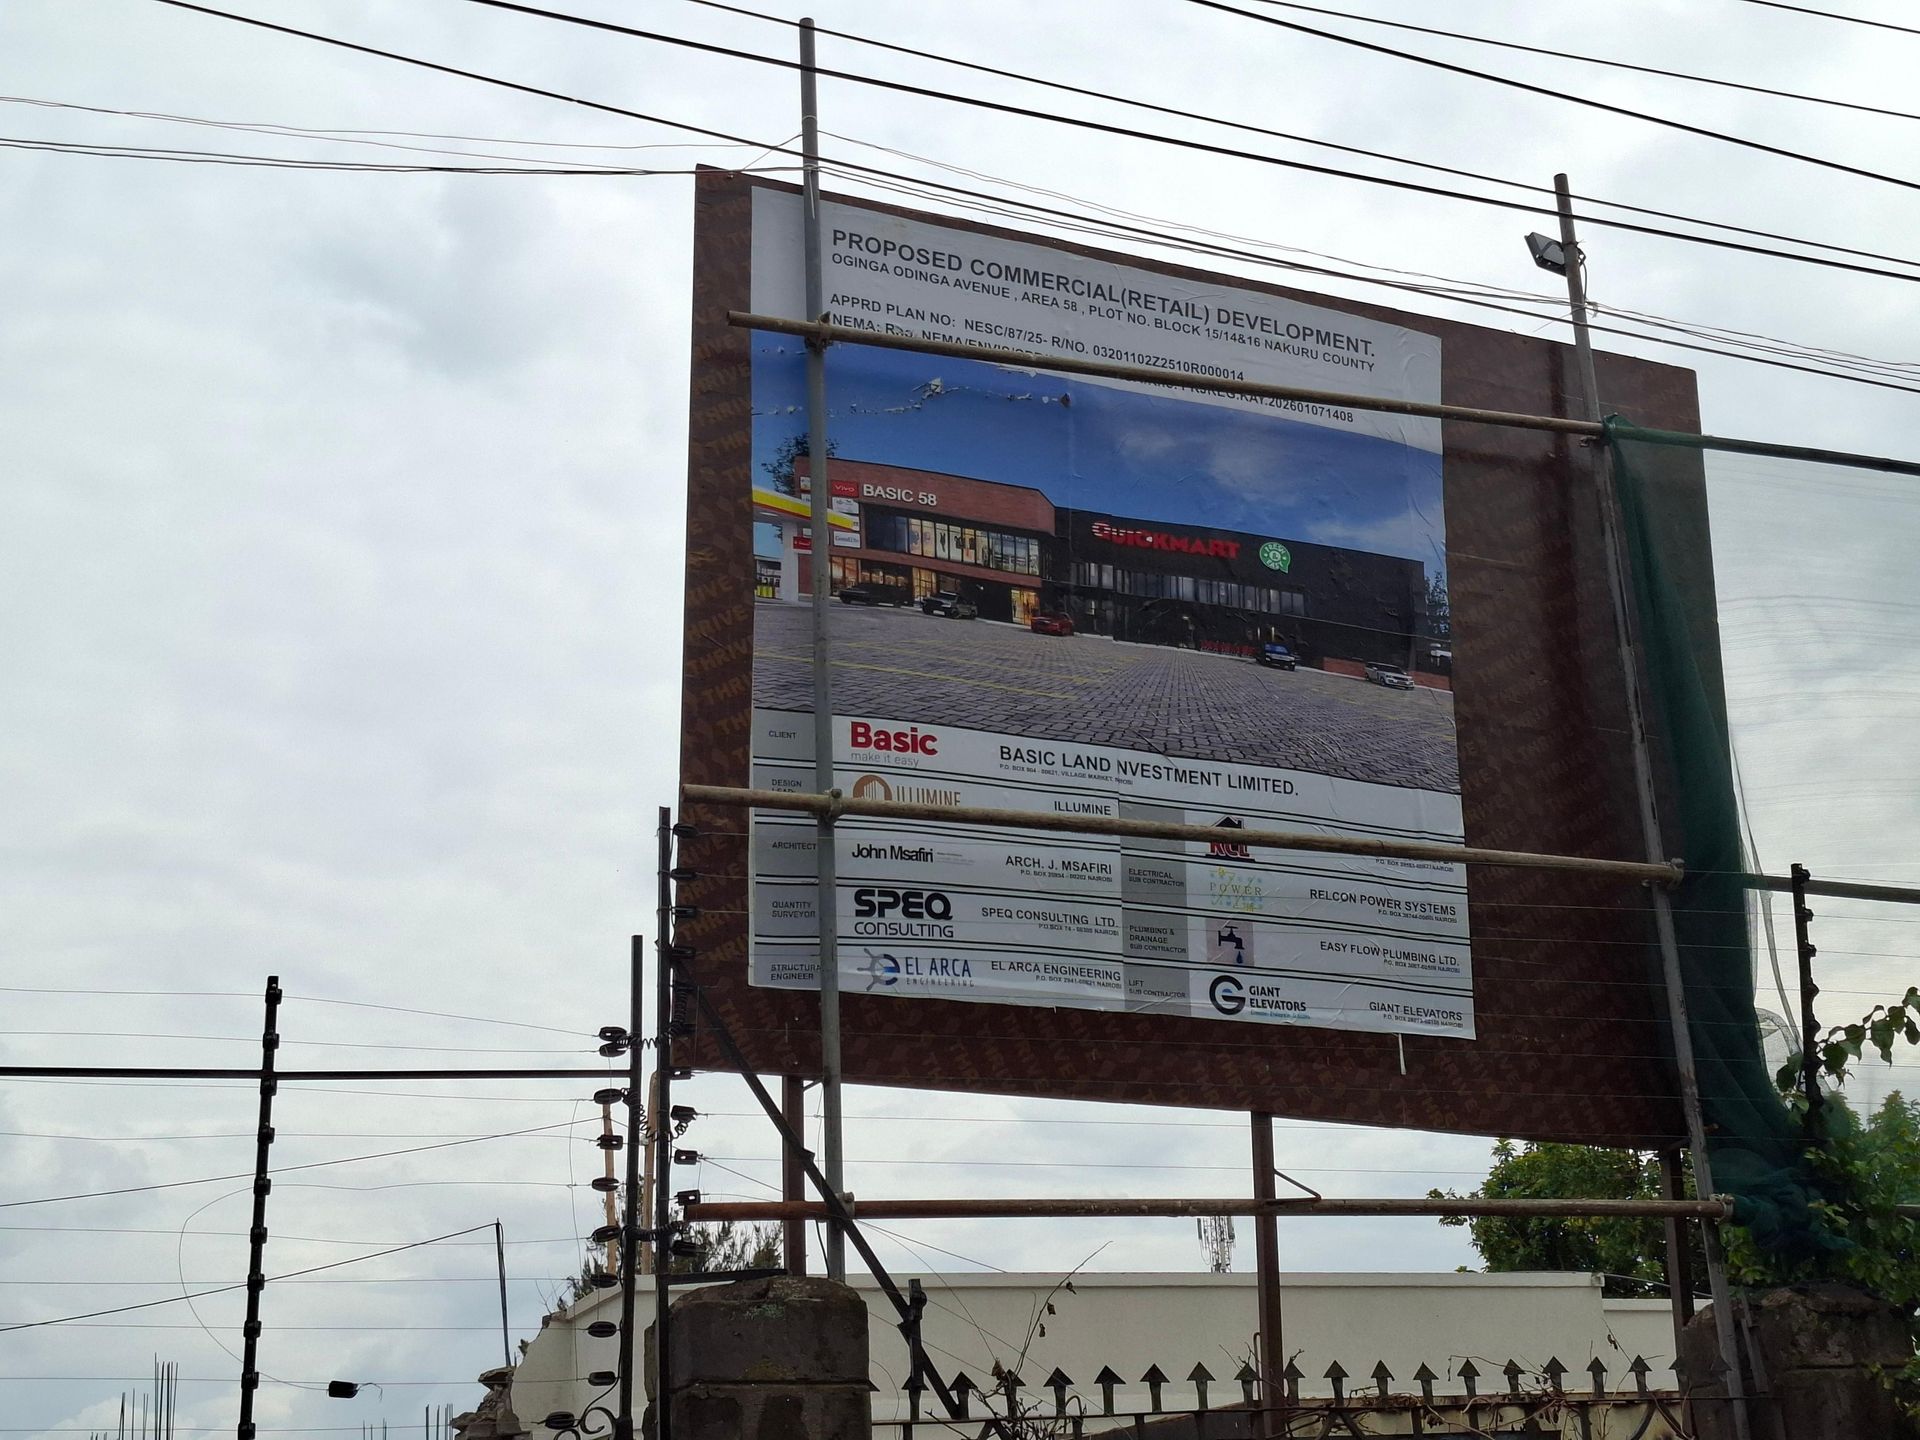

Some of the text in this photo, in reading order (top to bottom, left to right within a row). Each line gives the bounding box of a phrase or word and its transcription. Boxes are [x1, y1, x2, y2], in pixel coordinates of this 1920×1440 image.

[832, 229, 1375, 357] PROPOSED COMMERCIAL(RETAIL) DEVELOPMENT.
[832, 253, 889, 274] OGINGA
[894, 265, 951, 287] ODINGA
[953, 279, 1010, 299] AVENUE
[1022, 292, 1060, 309] AREA
[1063, 300, 1078, 312] 58
[1088, 303, 1123, 321] PLOT
[1127, 312, 1151, 327] NO.
[1154, 317, 1201, 336] BLOCK
[1204, 327, 1261, 348] 15/14&16
[1264, 338, 1319, 360] NAKURU
[1322, 352, 1375, 372] COUNTY
[832, 313, 881, 334] NEMA:
[830, 293, 882, 312] APPRD
[886, 303, 925, 321] PLAN
[930, 312, 956, 329] NO:
[964, 318, 1048, 344] NESC/87/25-
[1051, 335, 1089, 355] R/NO.
[1092, 345, 1244, 381] 03201102Z2510R000014
[862, 484, 914, 503] BASIC
[918, 491, 937, 506] 58
[768, 729, 797, 740] CLIENT
[850, 720, 939, 756] Basic
[850, 751, 919, 768] make it easy
[1000, 746, 1056, 766] BASIC
[1062, 752, 1111, 773] LAND
[1227, 774, 1300, 796] LIMITED.
[771, 778, 802, 787] DESIGN
[1054, 800, 1112, 816] ILLUMINE
[772, 841, 817, 850] ARCHITECT
[852, 844, 887, 860] John
[890, 846, 934, 863] Msafiri
[1005, 855, 1112, 875] ARCH. J. MSAFIRI
[1033, 870, 1047, 878] BOX
[1128, 868, 1173, 879] ELECTRICAL
[1142, 878, 1185, 888] CONTRACTOR
[1209, 882, 1262, 896] POWER
[772, 901, 812, 910] QUANTITY
[854, 888, 953, 921] SPEQ
[1310, 888, 1456, 916] RELCON POWER SYSTEMS
[771, 910, 816, 918] SURVEYOR
[981, 907, 1119, 928] SPEQ CONSULTING LTD.
[854, 921, 954, 938] CONSULTING
[1129, 925, 1168, 935] PLUMBING
[1129, 934, 1168, 944] DRAINAGE
[1144, 945, 1187, 954] CONTRACTOR
[1320, 941, 1348, 953] EASY
[1350, 944, 1380, 957] FLOW
[1383, 949, 1436, 964] PLUMBING
[1439, 954, 1460, 967] LTD.
[771, 964, 822, 972] STRUCTURA
[906, 957, 972, 978] EL ARCA
[991, 960, 1121, 982] EL ARCA ENGINEERING
[771, 972, 814, 981] ENGINEER
[1128, 979, 1144, 987] LIFT
[1143, 989, 1186, 998] CONTRACTOR
[1249, 985, 1281, 998] GIANT
[1250, 998, 1307, 1012] ELEVATORS
[1369, 1001, 1402, 1014] GIANT
[1403, 1003, 1463, 1021] ELEVATORS
